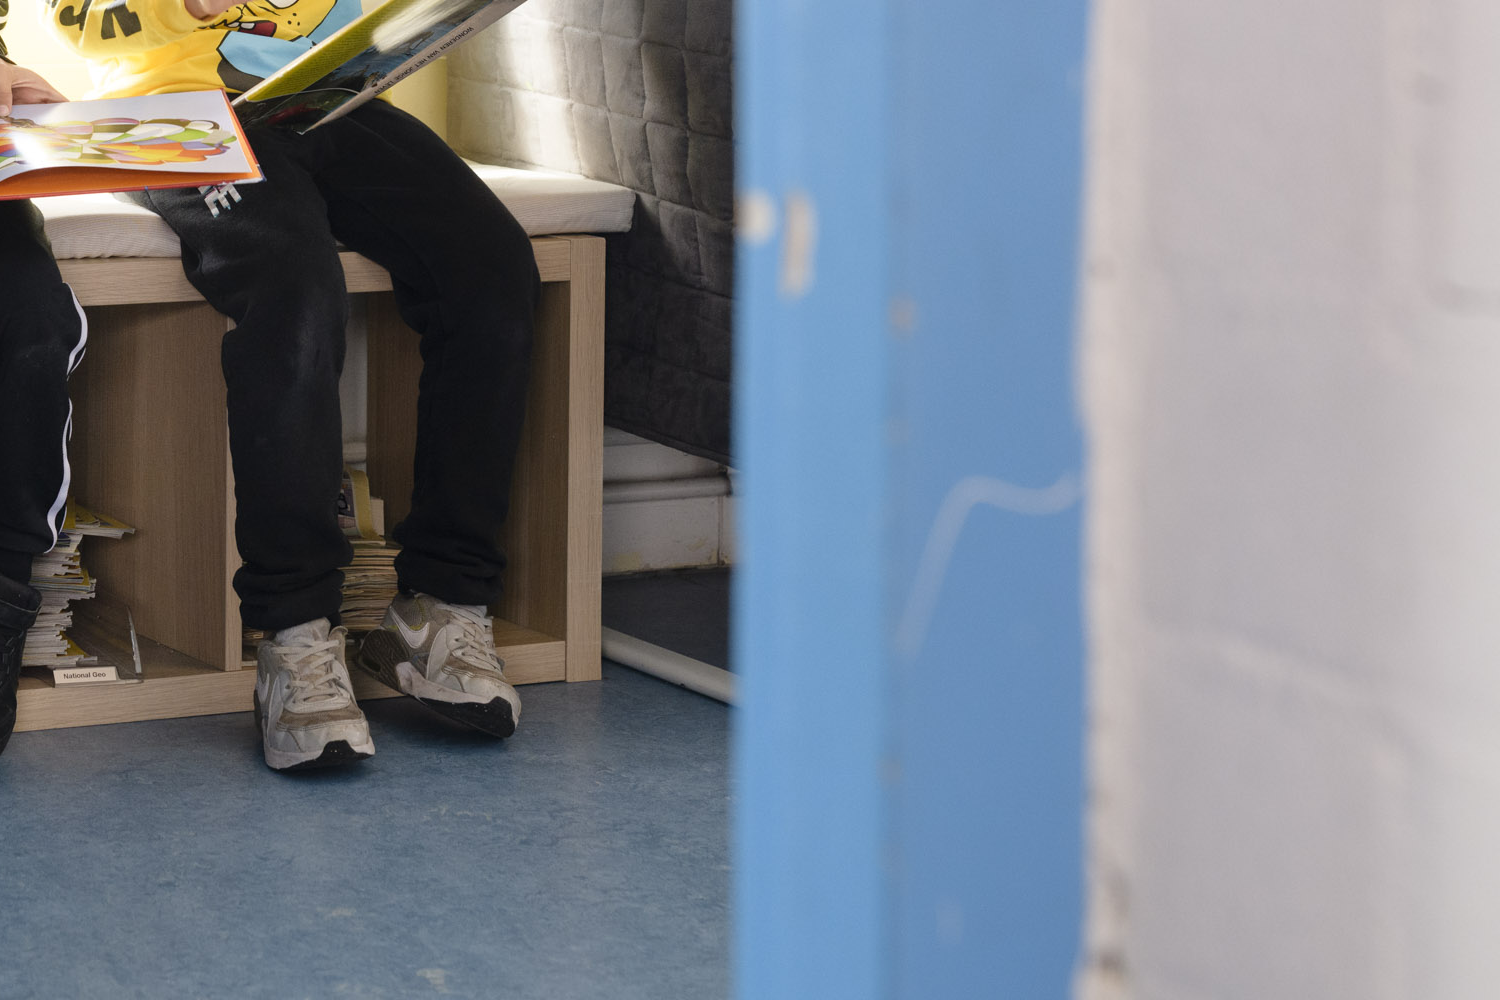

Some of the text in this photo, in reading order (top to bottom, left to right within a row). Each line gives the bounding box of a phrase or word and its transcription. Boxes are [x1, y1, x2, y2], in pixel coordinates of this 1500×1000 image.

[440, 26, 474, 51] WONDEREN
[427, 50, 440, 60] VAN
[415, 58, 427, 68] HET
[374, 80, 394, 94] LEVEN
[63, 672, 90, 680] National
